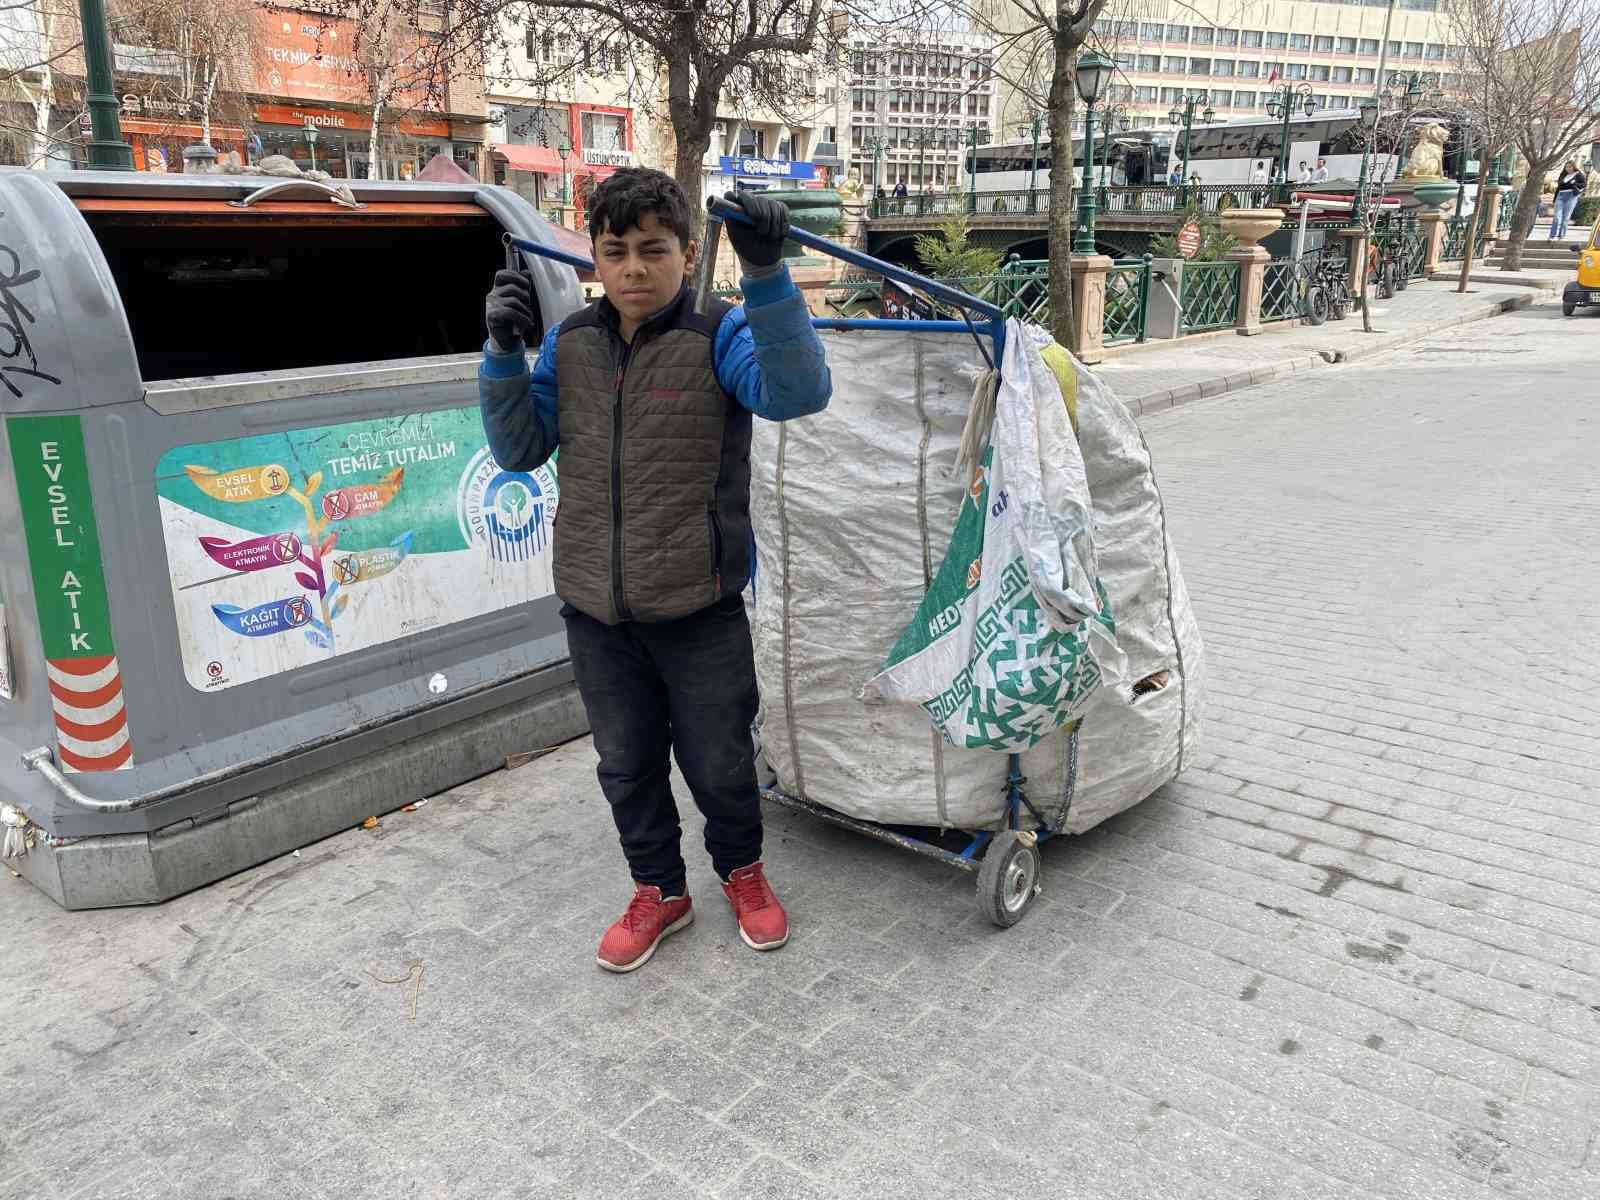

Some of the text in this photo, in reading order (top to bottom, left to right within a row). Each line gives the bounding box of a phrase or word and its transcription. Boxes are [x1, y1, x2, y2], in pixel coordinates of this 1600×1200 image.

[304, 114, 345, 127] mobile
[386, 440, 456, 467] TUTALIM
[216, 473, 256, 488] EVSEL
[354, 490, 379, 503] CAM
[41, 441, 93, 651] EVSEL ATIK
[235, 554, 267, 567] ATMAYIN
[247, 621, 278, 633] ATMAYIN
